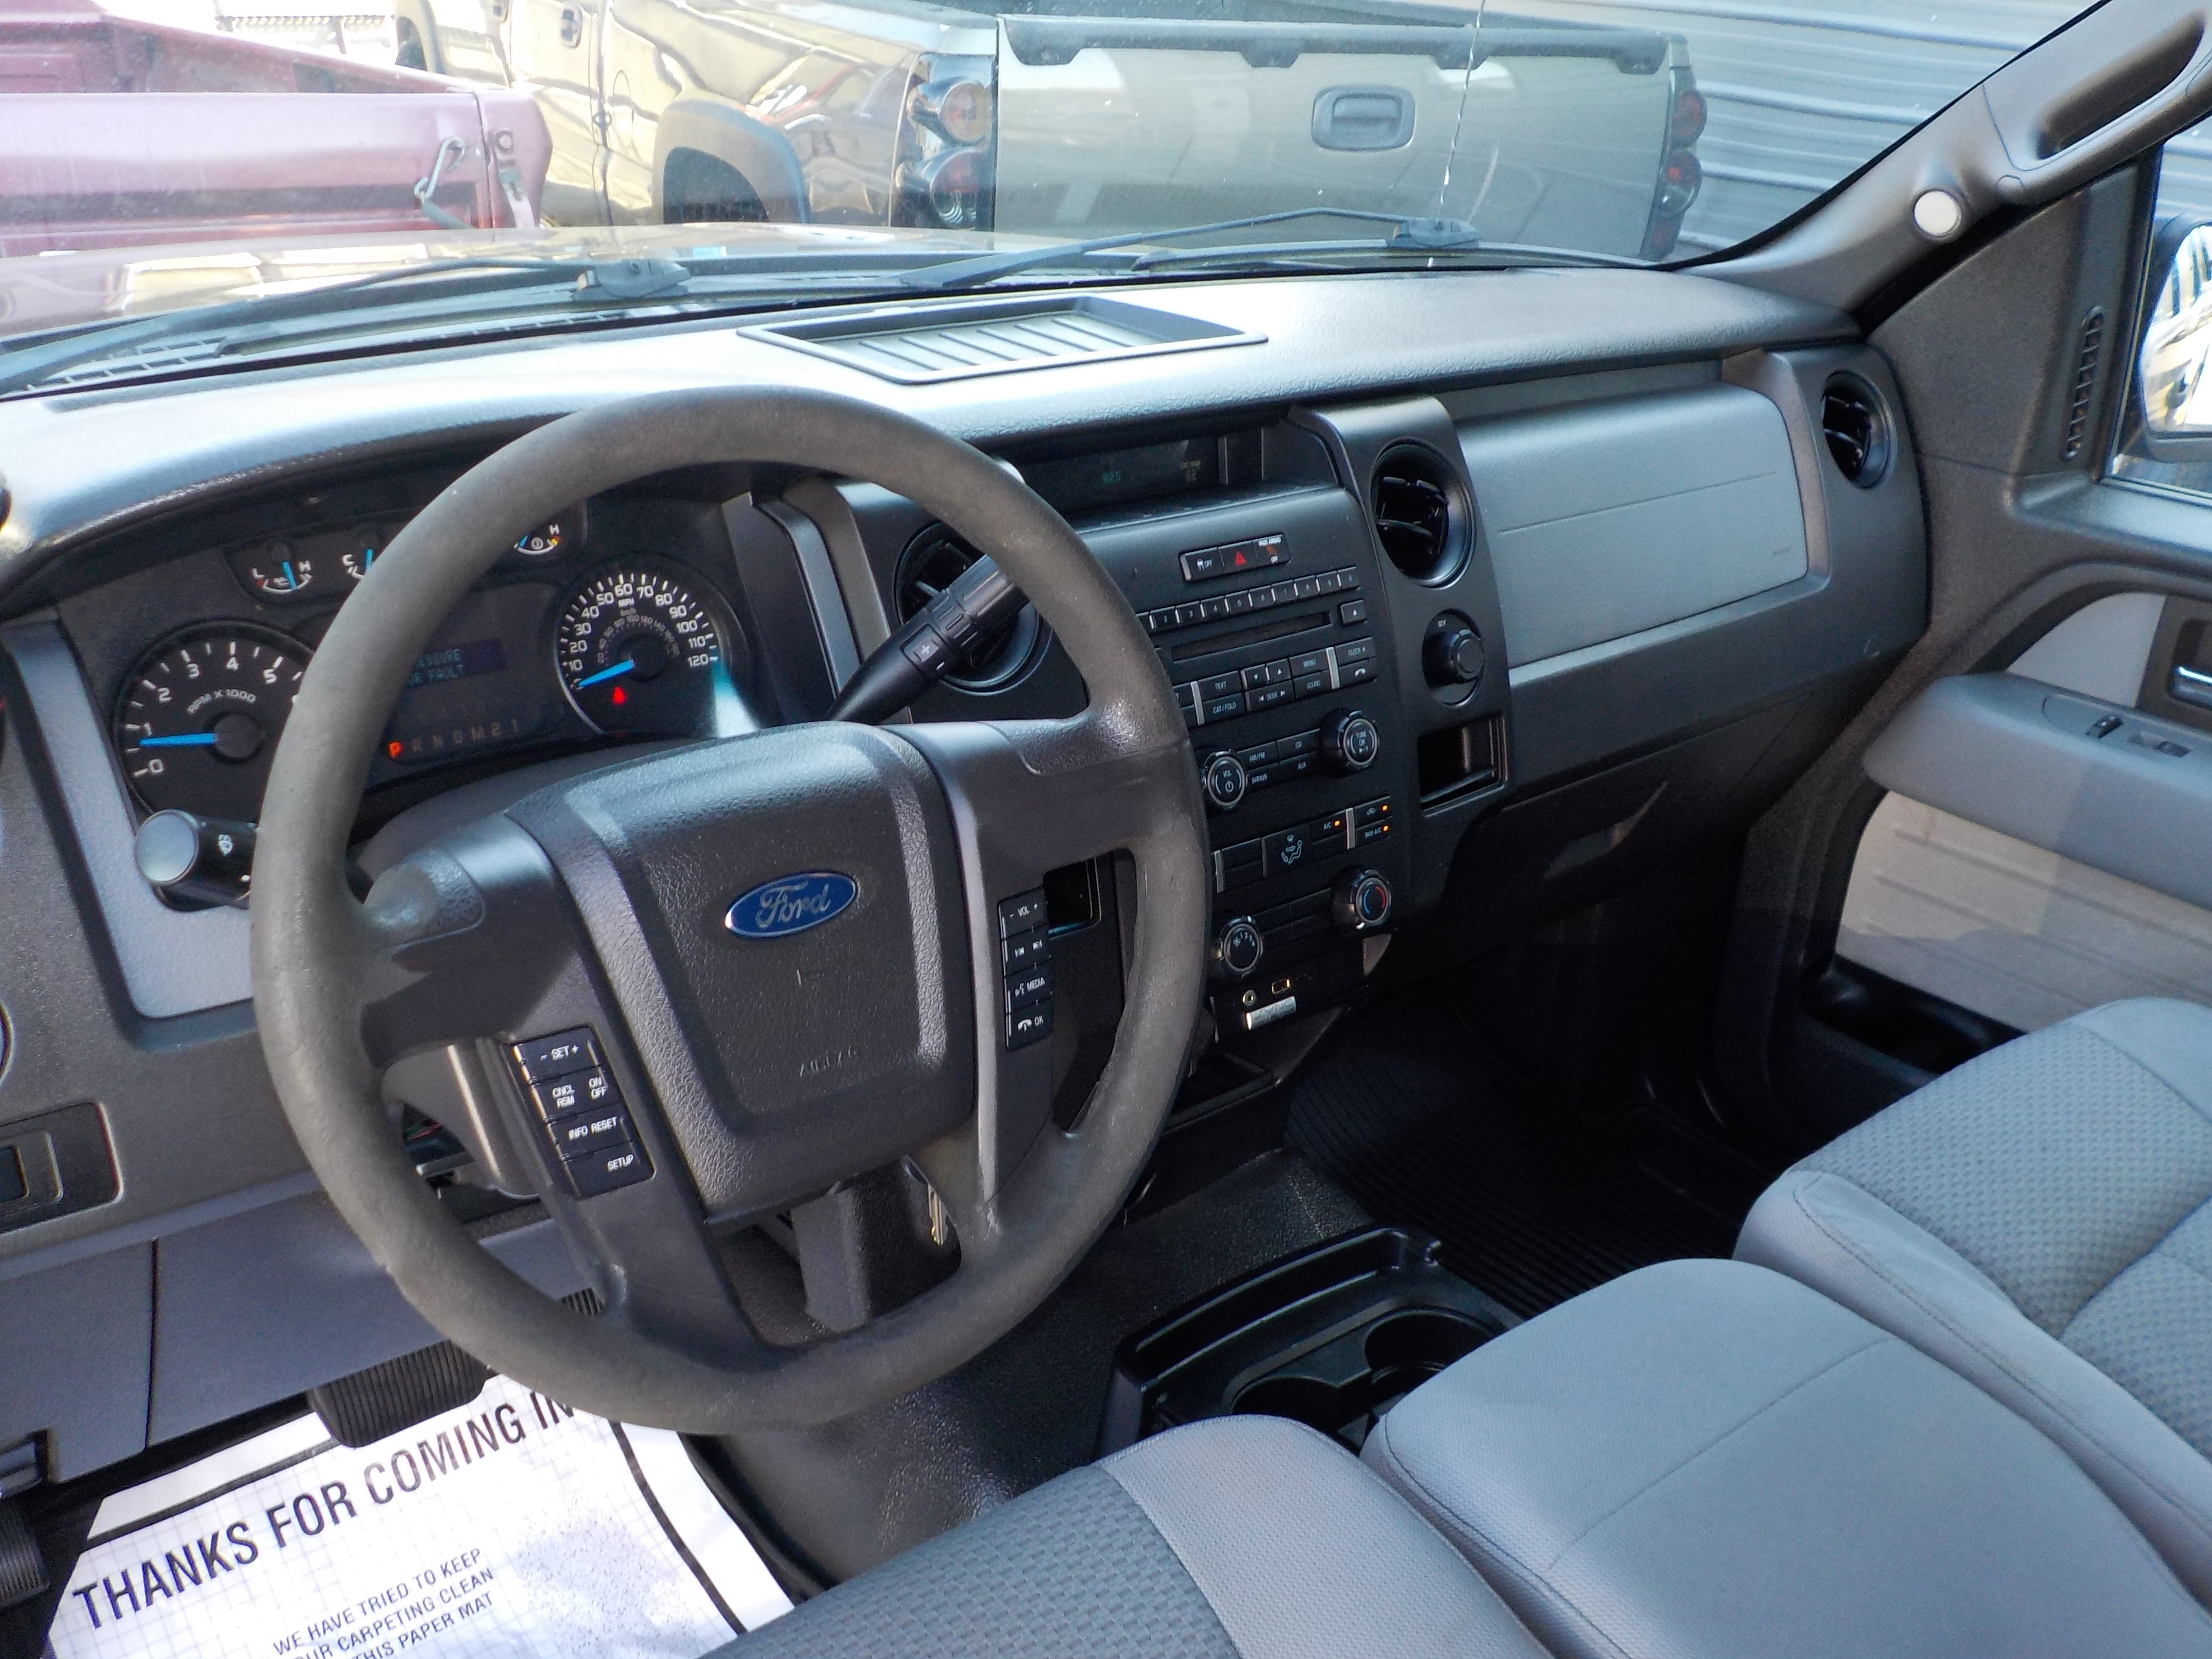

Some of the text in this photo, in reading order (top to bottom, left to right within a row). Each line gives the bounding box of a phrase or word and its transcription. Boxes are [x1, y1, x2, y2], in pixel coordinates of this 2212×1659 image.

[549, 524, 560, 535] H
[298, 560, 312, 572] H
[1204, 559, 1212, 568] OFF
[252, 567, 265, 580] L
[614, 583, 633, 598] 60
[636, 585, 654, 599] 70
[596, 592, 614, 607] 50
[655, 593, 673, 607] 80
[581, 605, 599, 618] 40
[669, 605, 687, 619] 90
[574, 622, 592, 636] 30
[675, 619, 698, 634] 100
[569, 640, 588, 654] 20
[688, 635, 706, 649] 110
[227, 657, 239, 672] 4
[568, 659, 583, 672] 10
[688, 653, 709, 668] 120
[187, 664, 200, 680] 3
[263, 668, 277, 685] 5
[1214, 681, 1227, 690] TEXT
[158, 688, 172, 702] 2
[187, 693, 212, 714] RPM
[225, 689, 257, 703] 1000
[144, 722, 153, 736] 1
[1249, 751, 1266, 761] AM/FM
[149, 759, 164, 775] 0
[1297, 761, 1306, 770] AUX
[1223, 770, 1232, 778] VOL
[1251, 773, 1268, 784] SIRIUS
[1323, 821, 1332, 831] A/C
[755, 880, 832, 930] Ford
[1017, 905, 1030, 918] VOL
[1027, 976, 1045, 992] MEDIA
[1034, 1015, 1044, 1027] OK
[551, 1045, 571, 1061] SET
[589, 1076, 603, 1090] ON
[552, 1084, 575, 1099] CNCL
[591, 1087, 607, 1100] OFF
[556, 1094, 575, 1109] RSM
[568, 1116, 617, 1141] INFO RESET
[607, 1153, 634, 1172] SETUP
[73, 1521, 258, 1629] THANKS
[267, 1480, 356, 1548] FOR
[364, 1402, 525, 1504] COMING
[273, 1547, 481, 1655] WE HAVE TRIED TO KEEP
[337, 1596, 435, 1651] CARPETING
[439, 1567, 494, 1604] CLEAN
[398, 1612, 455, 1649] PAPER
[458, 1590, 493, 1620] MAT
